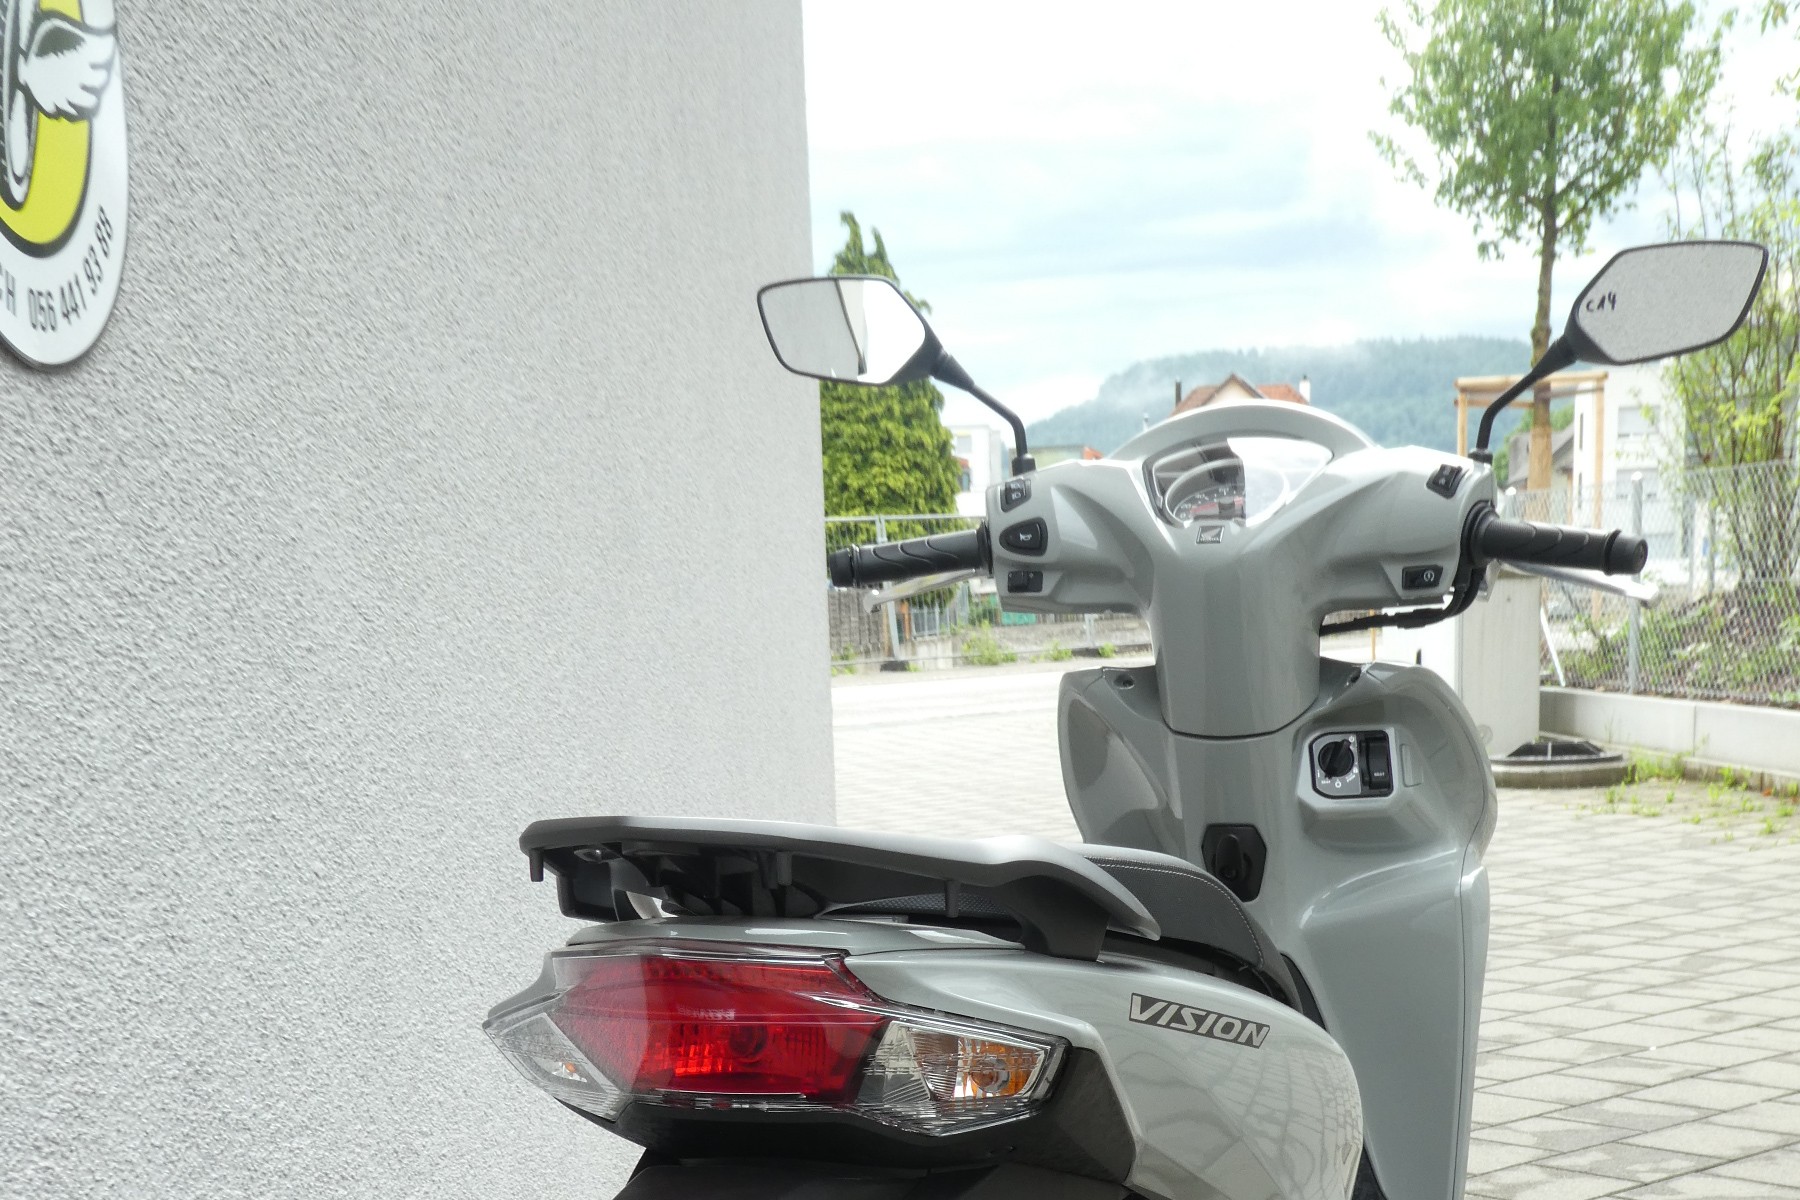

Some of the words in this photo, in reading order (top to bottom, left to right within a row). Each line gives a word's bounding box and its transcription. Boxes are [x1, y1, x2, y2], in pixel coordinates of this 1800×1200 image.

[28, 286, 57, 333] 056
[60, 273, 87, 325] 441
[83, 244, 104, 296] 93
[94, 203, 113, 259] 88
[1130, 994, 1270, 1048] VISION
